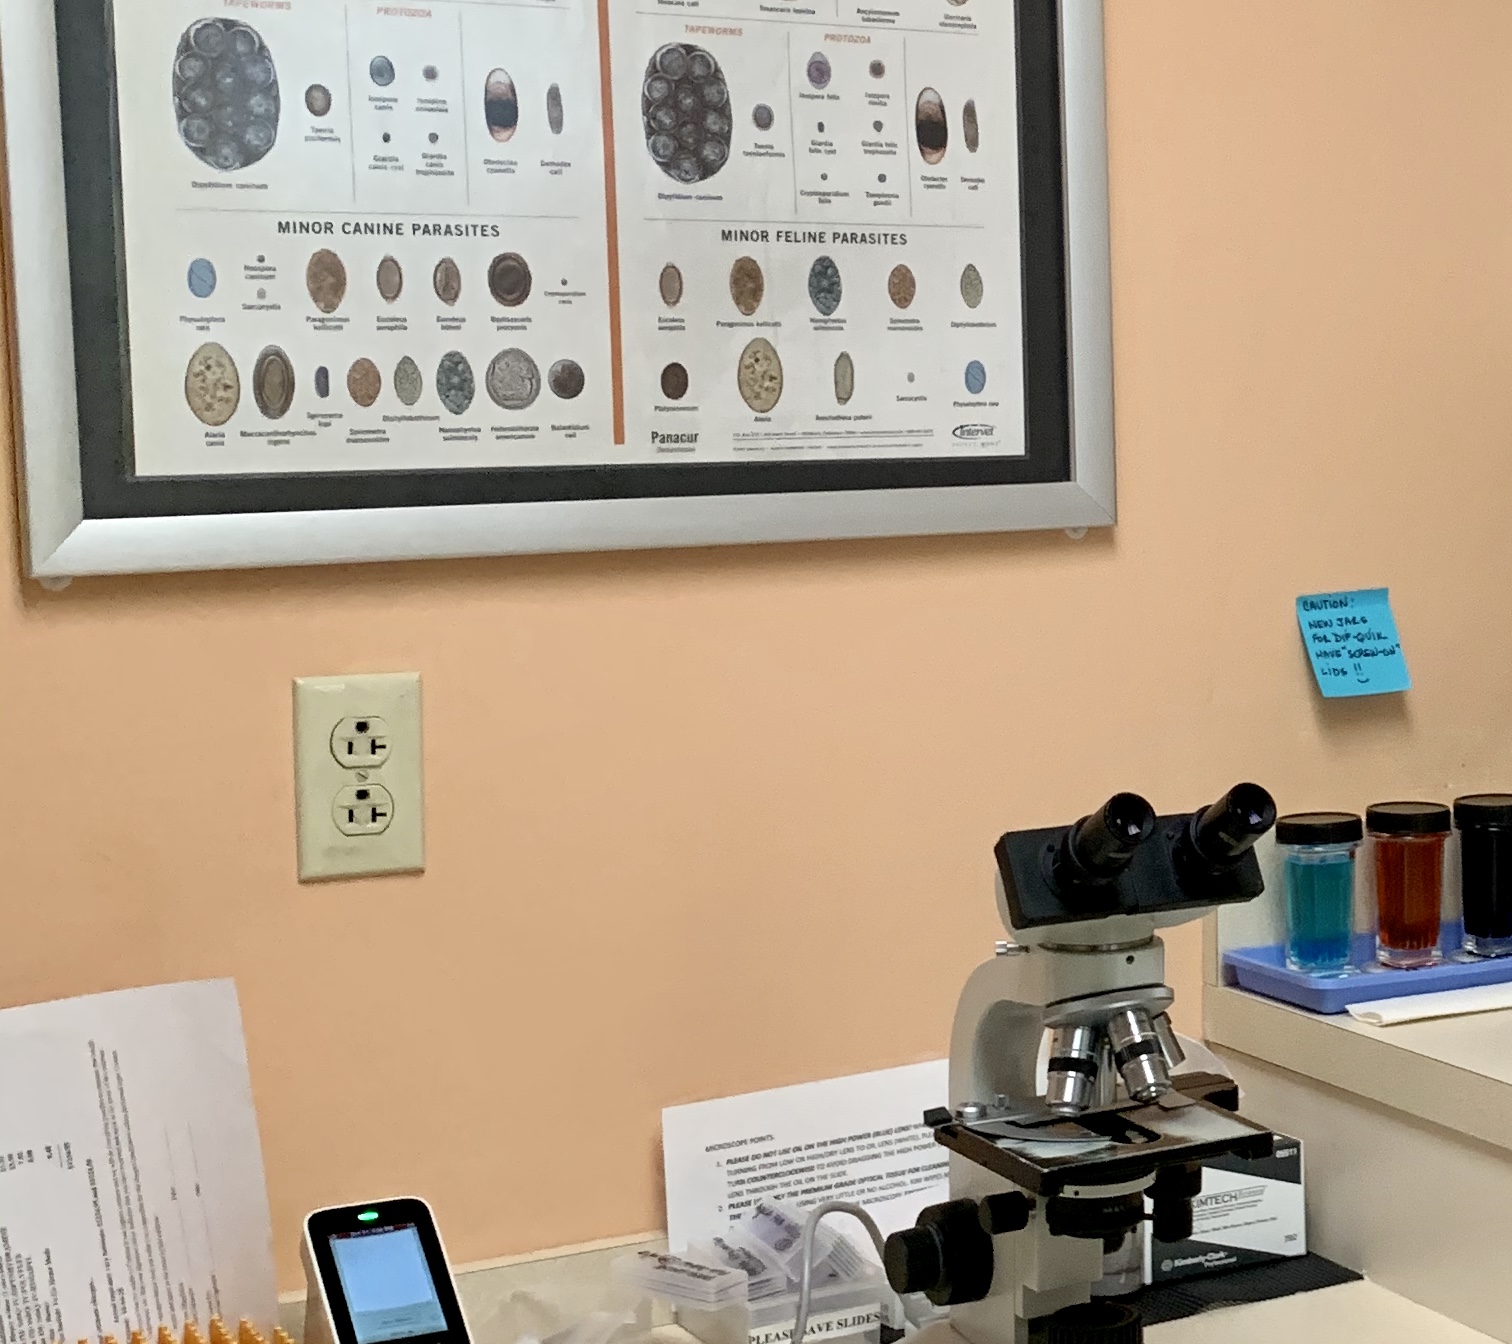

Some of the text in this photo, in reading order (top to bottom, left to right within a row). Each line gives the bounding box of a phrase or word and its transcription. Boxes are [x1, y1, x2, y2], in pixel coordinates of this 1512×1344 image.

[684, 24, 744, 37] TAPEWORMS
[823, 33, 872, 45] PROTOZOA
[278, 221, 500, 238] MINOR CANINE PARASITES
[722, 230, 908, 246] MINOR FELINE PARASITES
[651, 431, 700, 445] Panacur
[726, 1155, 749, 1165] PLEASE
[848, 1132, 871, 1142] POWER
[728, 1199, 752, 1210] PLEASE
[1193, 1193, 1238, 1208] IMTECH
[803, 1320, 834, 1337] AVE
[836, 1311, 880, 1331] SLIDES
